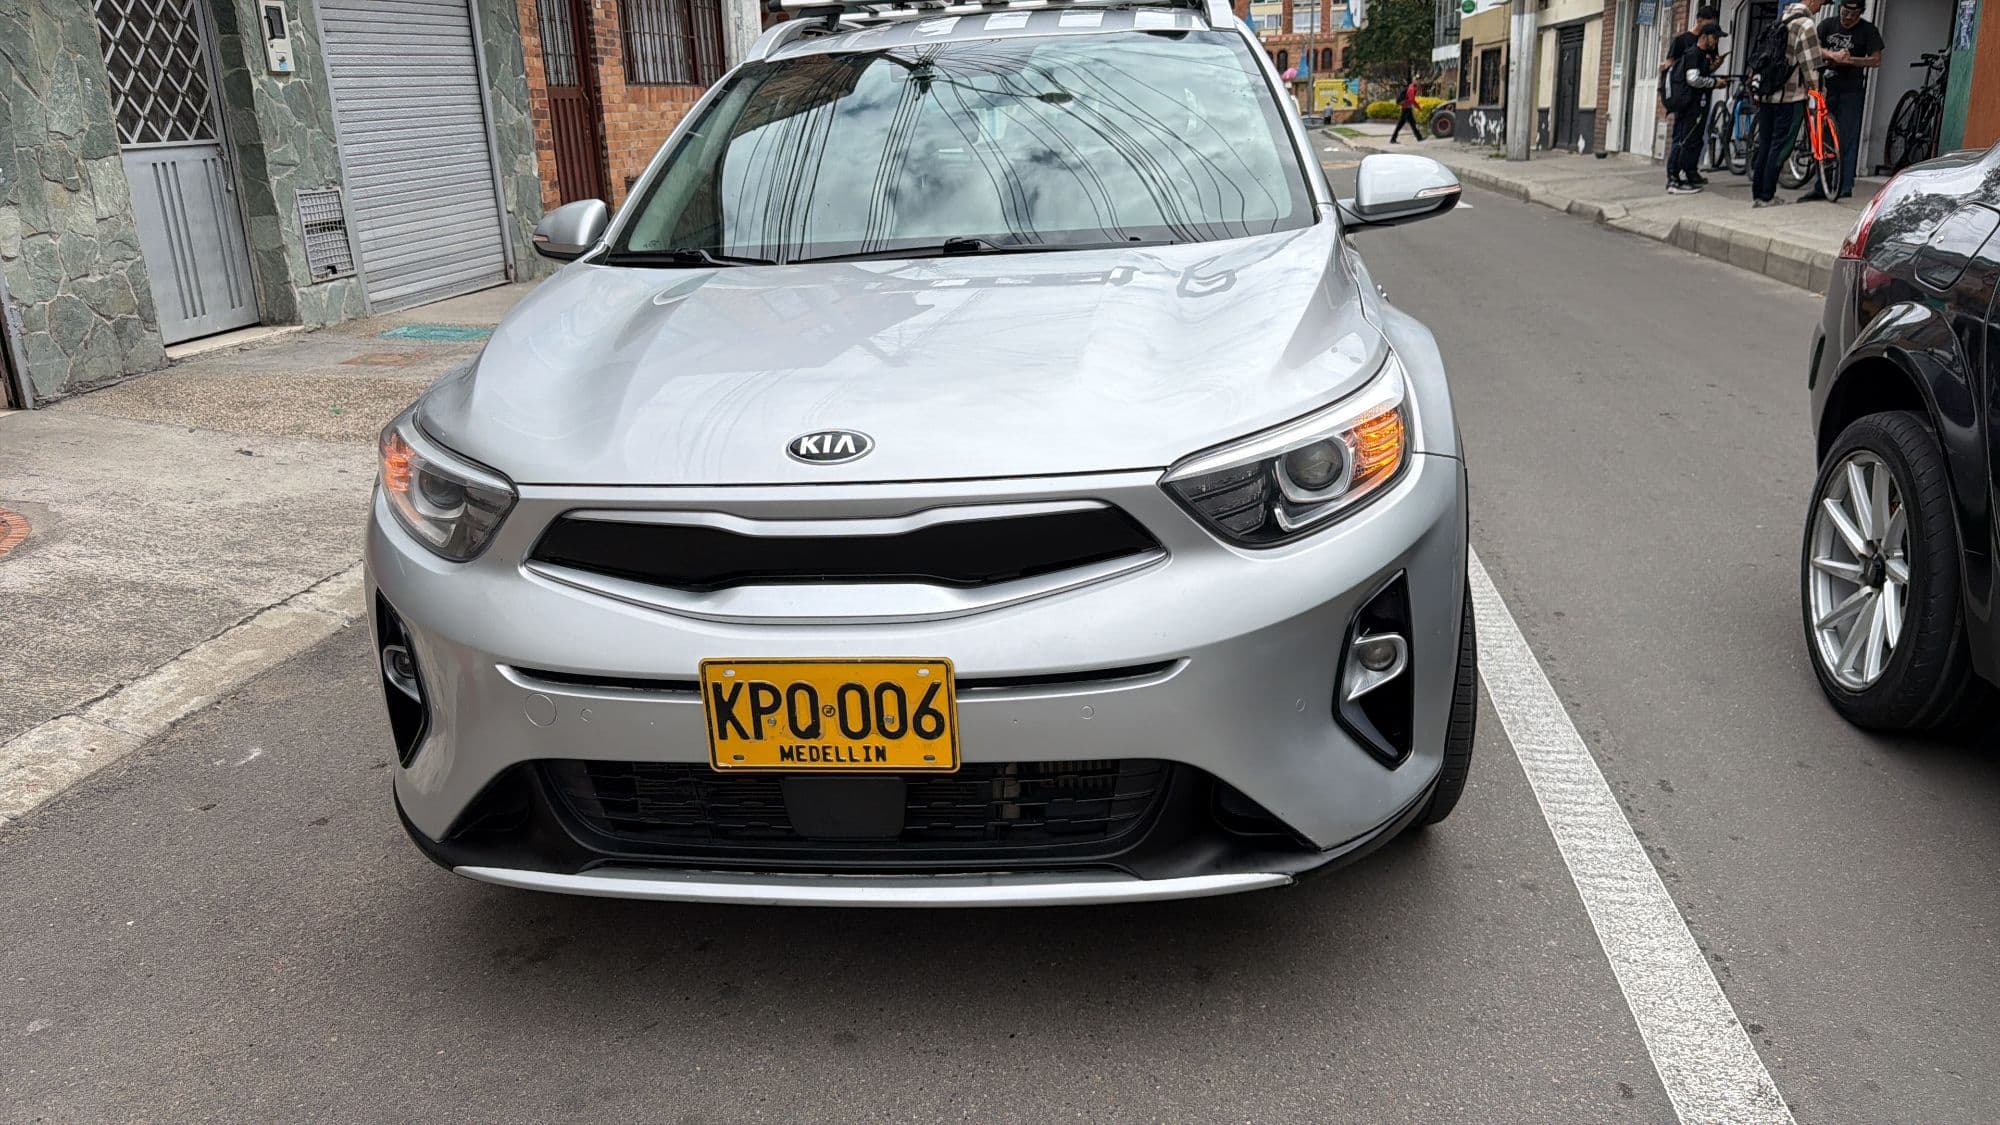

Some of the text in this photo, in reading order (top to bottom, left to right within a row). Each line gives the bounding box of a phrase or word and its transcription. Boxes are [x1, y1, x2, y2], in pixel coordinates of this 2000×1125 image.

[800, 434, 856, 454] KIA
[711, 681, 945, 741] KPQ 006
[779, 745, 887, 762] MEDELLIN
